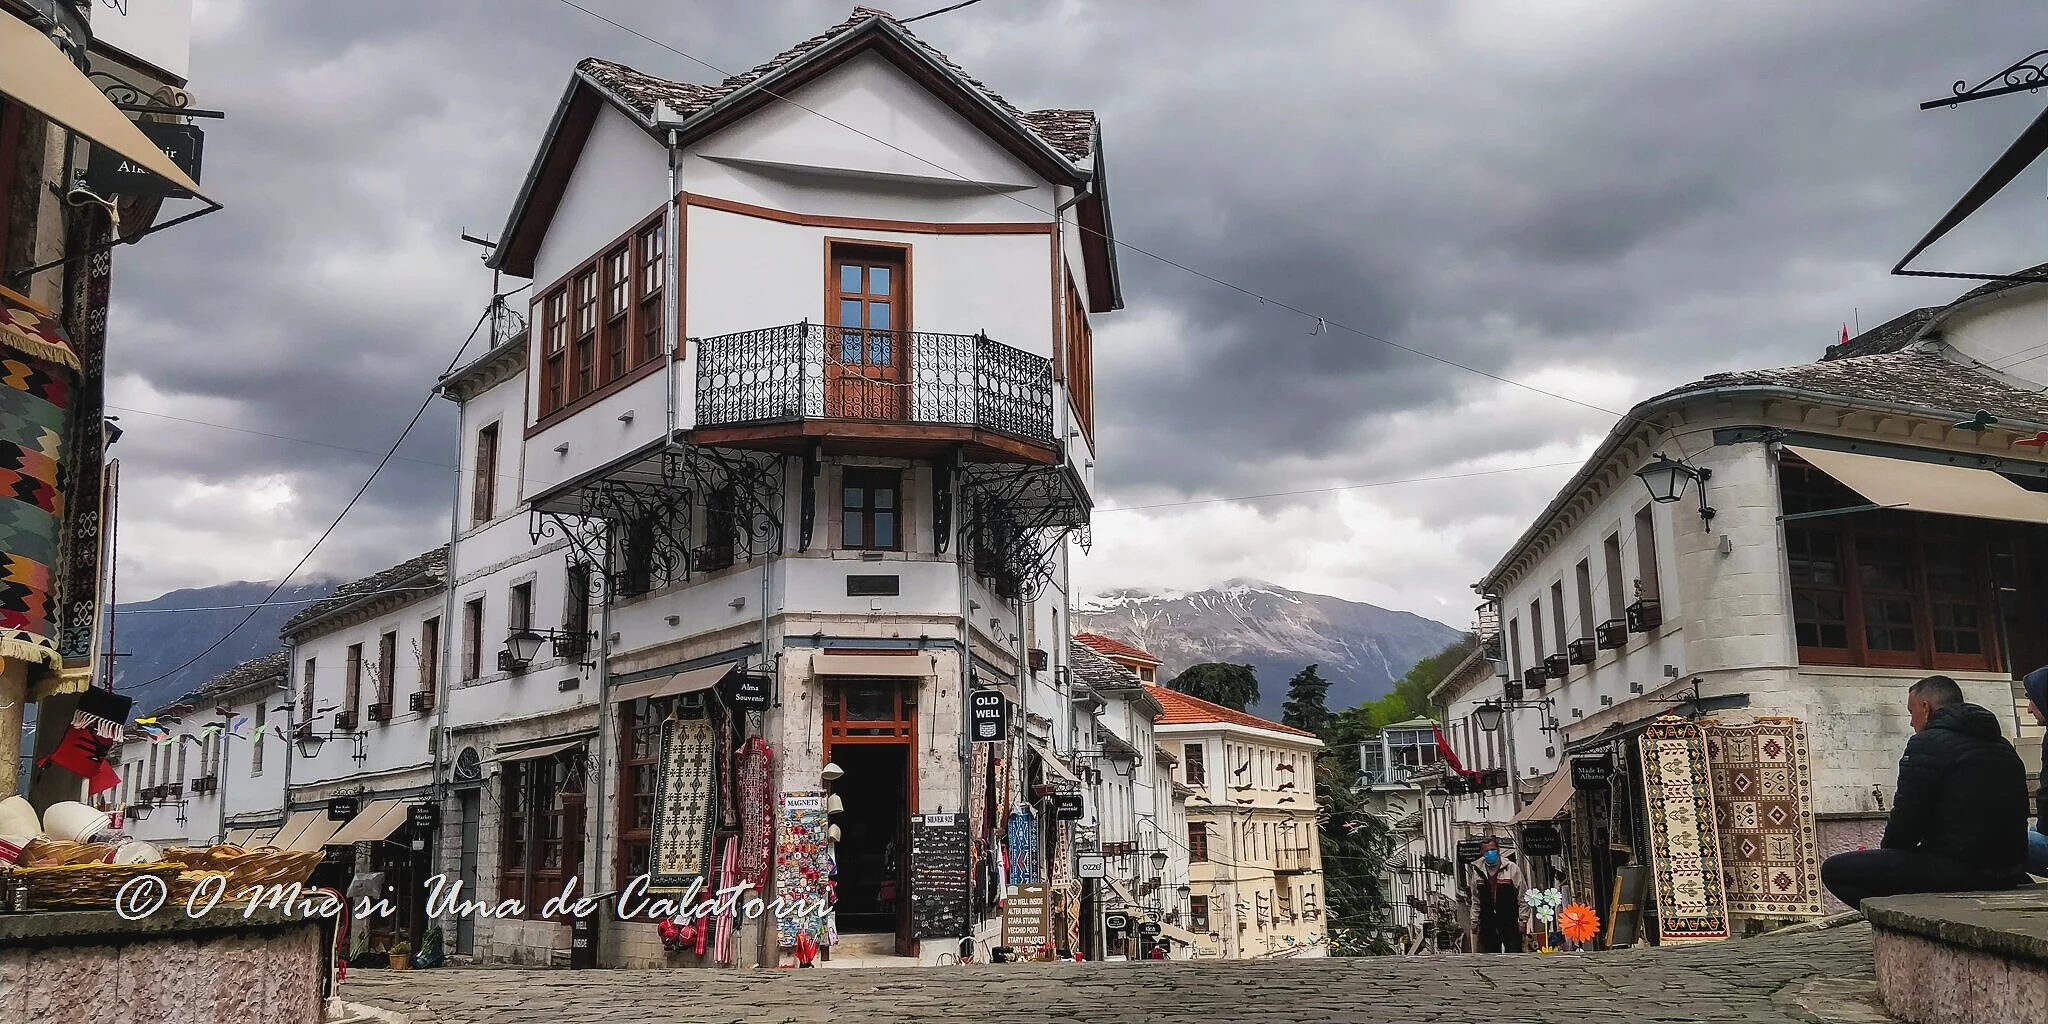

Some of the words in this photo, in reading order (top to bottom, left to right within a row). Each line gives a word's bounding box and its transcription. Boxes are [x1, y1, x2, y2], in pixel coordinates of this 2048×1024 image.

[741, 683, 759, 691] Alma
[735, 693, 765, 702] Souvenir
[976, 696, 999, 706] OLD
[975, 709, 1000, 718] WELL
[1578, 766, 1596, 774] Made
[927, 815, 944, 823] SILVER
[575, 920, 587, 929] WELL
[573, 938, 587, 948] INSIDE
